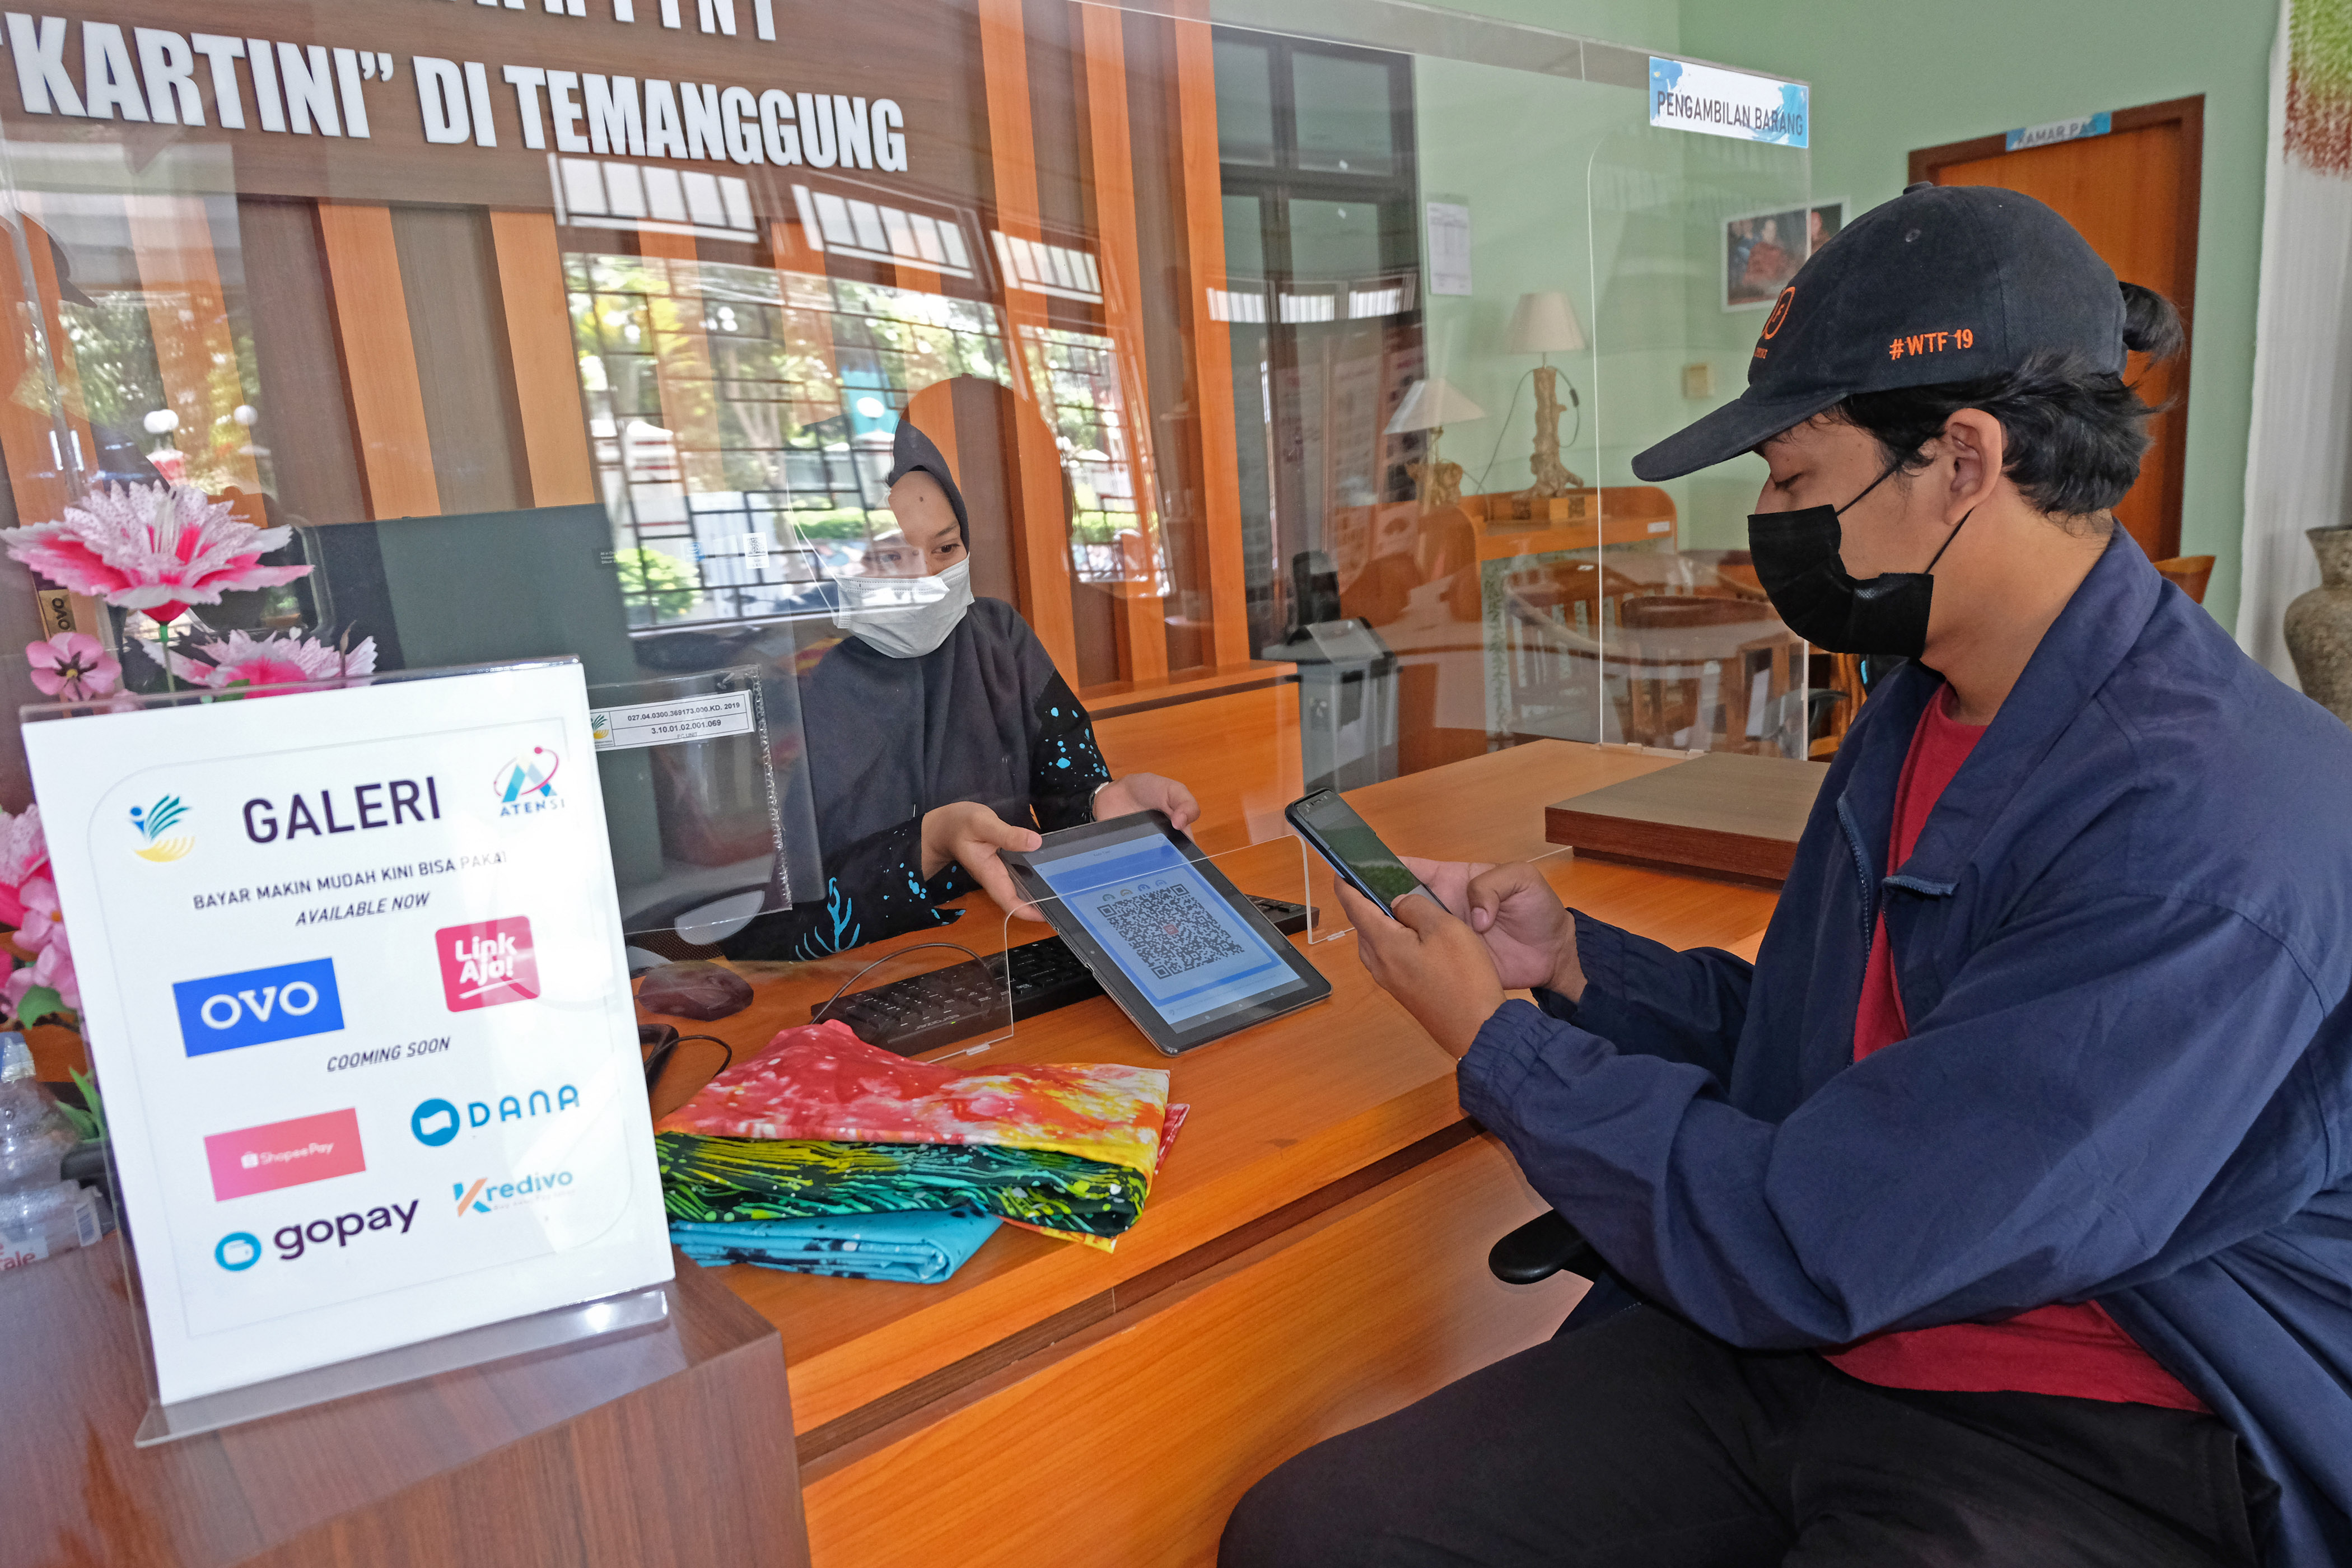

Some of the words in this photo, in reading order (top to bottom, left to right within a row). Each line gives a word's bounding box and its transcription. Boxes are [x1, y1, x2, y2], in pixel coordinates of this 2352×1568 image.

[0, 11, 394, 139] KARTINI”
[412, 55, 497, 147] DI
[502, 64, 908, 172] TEMANGGUNG
[1657, 90, 1751, 127] PENGAMBILAN
[1754, 107, 1803, 136] BARANG
[1889, 332, 1949, 360] #WTF
[1954, 328, 1974, 349] 19
[651, 719, 721, 734] 3.10.01.02.001.069
[724, 702, 740, 711] 2019
[242, 776, 441, 844] GALERI
[500, 799, 566, 817] ATENSI
[193, 888, 250, 911] BAYAR
[256, 879, 311, 900] MAKIN
[317, 870, 376, 892] MUDAH
[381, 865, 414, 881] KINI
[418, 858, 456, 876] BISA
[295, 898, 386, 926] AVAILABLE
[392, 892, 431, 911] NOW
[455, 932, 517, 963] Link
[200, 981, 319, 1030] OVO
[327, 1045, 401, 1072] COOMING
[407, 1036, 451, 1058] SOON
[468, 1084, 580, 1128] DANA
[273, 1198, 419, 1261] gopay
